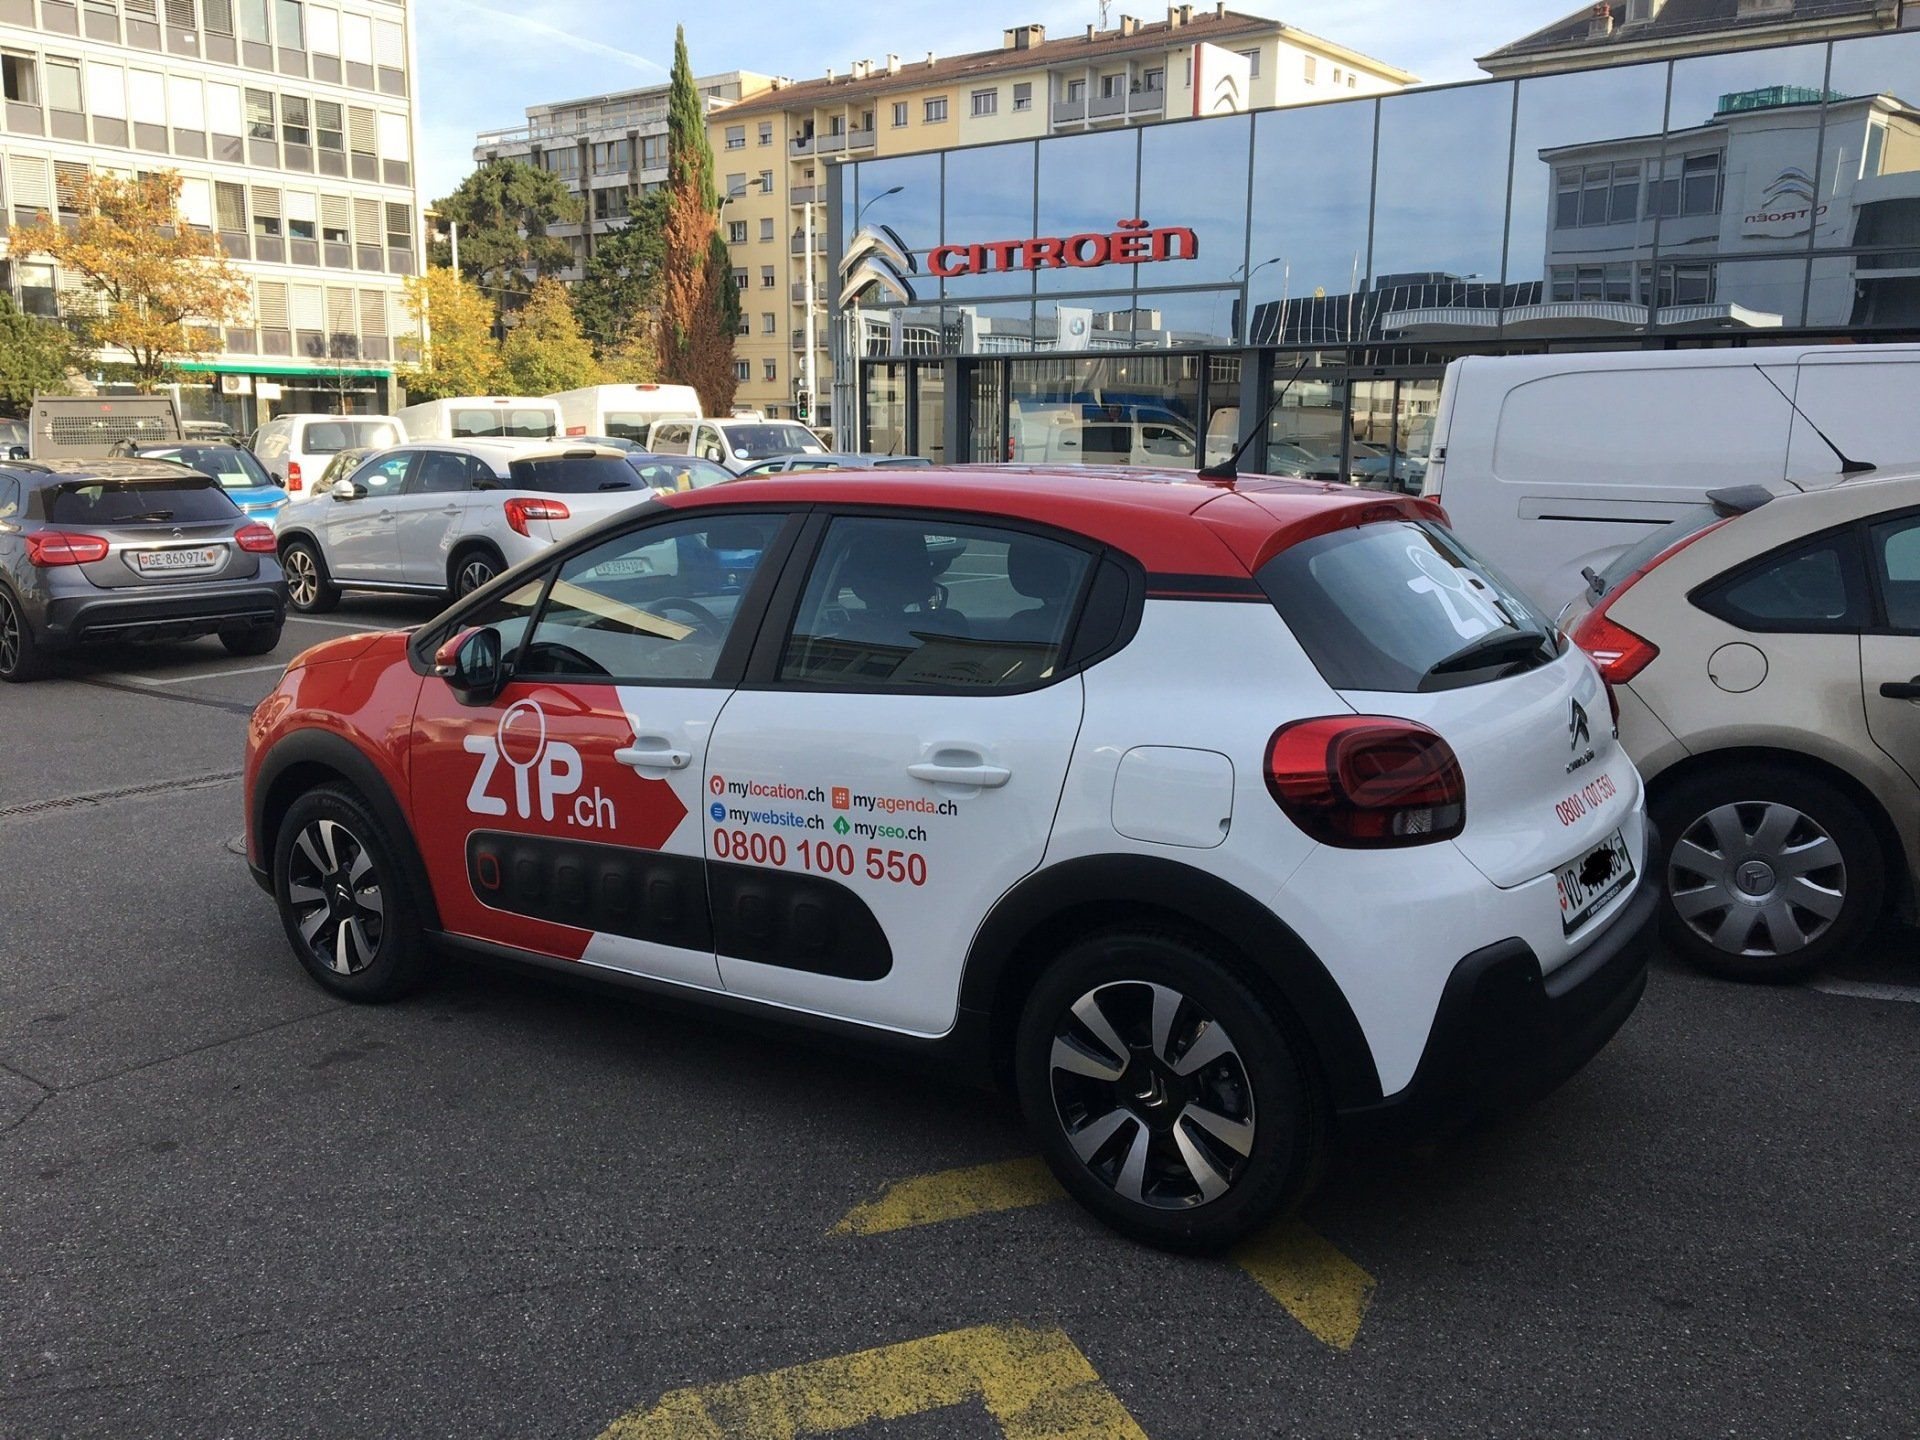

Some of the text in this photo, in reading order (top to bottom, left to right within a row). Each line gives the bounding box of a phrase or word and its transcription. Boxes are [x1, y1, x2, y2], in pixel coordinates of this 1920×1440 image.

[728, 780, 825, 802] mylocation.ch
[1555, 773, 1617, 826] 0800 100 550
[853, 793, 958, 816] myagenda.ch
[728, 806, 825, 830] mywebsite.ch
[854, 821, 927, 842] myseo.ch
[713, 828, 927, 887] 0800 100 550
[1560, 869, 1584, 910] VD
